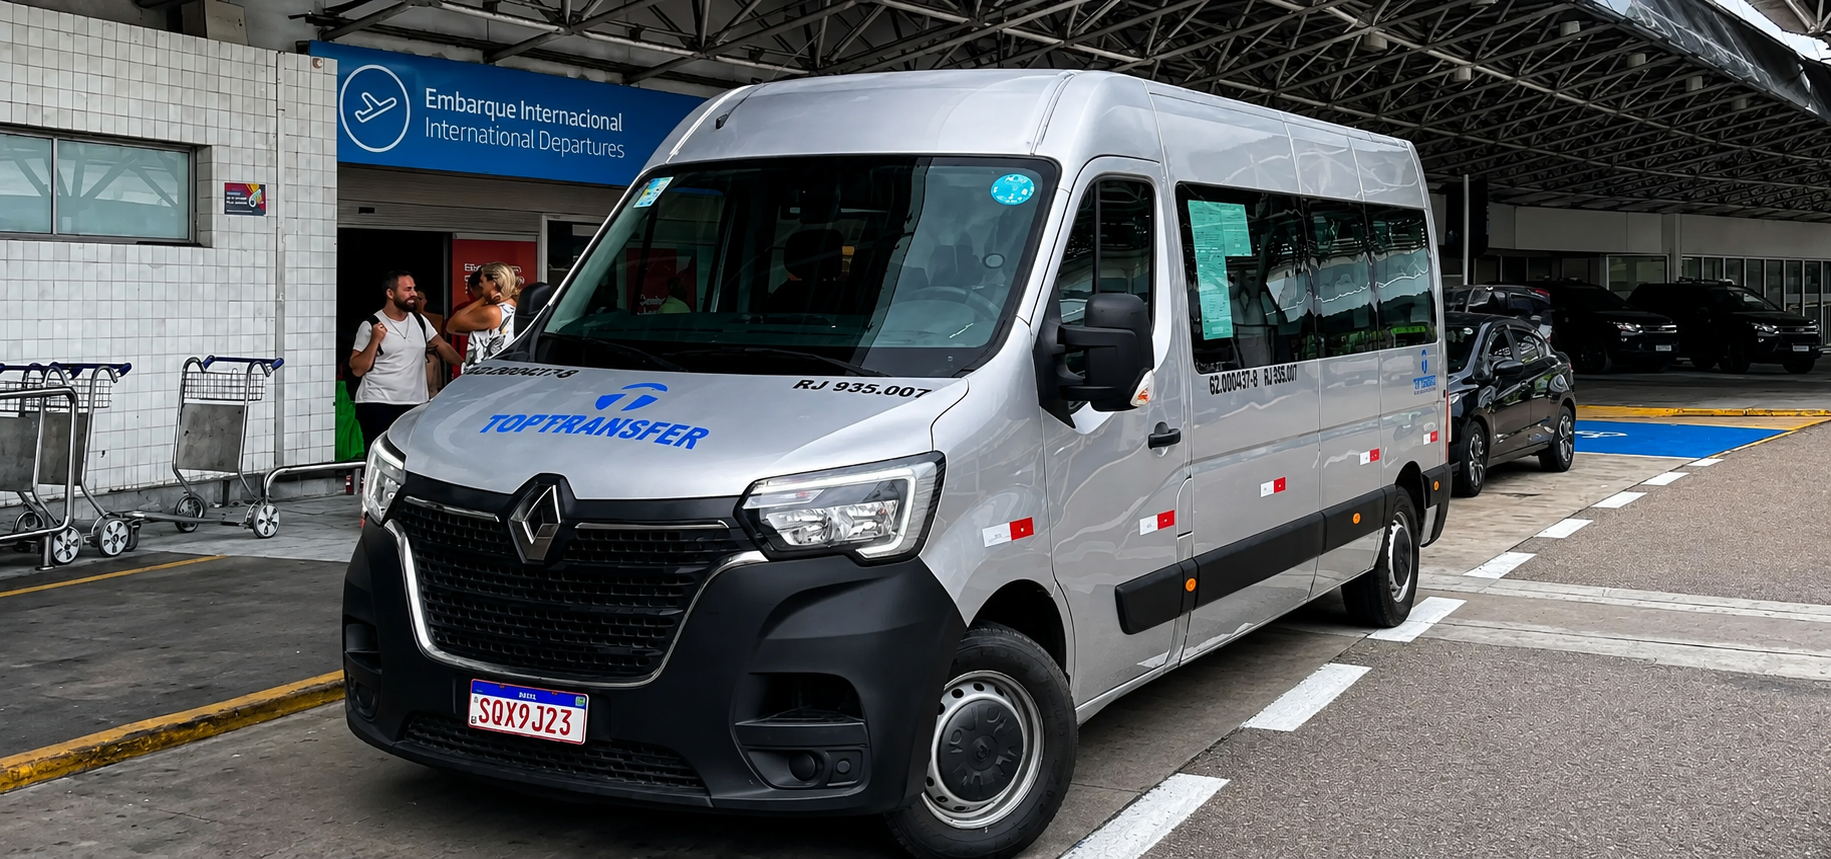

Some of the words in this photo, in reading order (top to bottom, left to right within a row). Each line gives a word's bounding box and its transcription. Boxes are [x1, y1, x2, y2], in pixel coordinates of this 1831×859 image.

[425, 88, 517, 122] Embarque
[520, 100, 623, 132] Internacional
[425, 117, 535, 149] International
[539, 130, 626, 159] Departures
[792, 379, 830, 390] RJ
[832, 382, 933, 399] 935.007
[1209, 369, 1258, 395] 62.000437-8
[1263, 366, 1273, 386] RJ
[479, 414, 710, 450] TOPTRANSFER
[478, 697, 573, 736] SQX9J23
